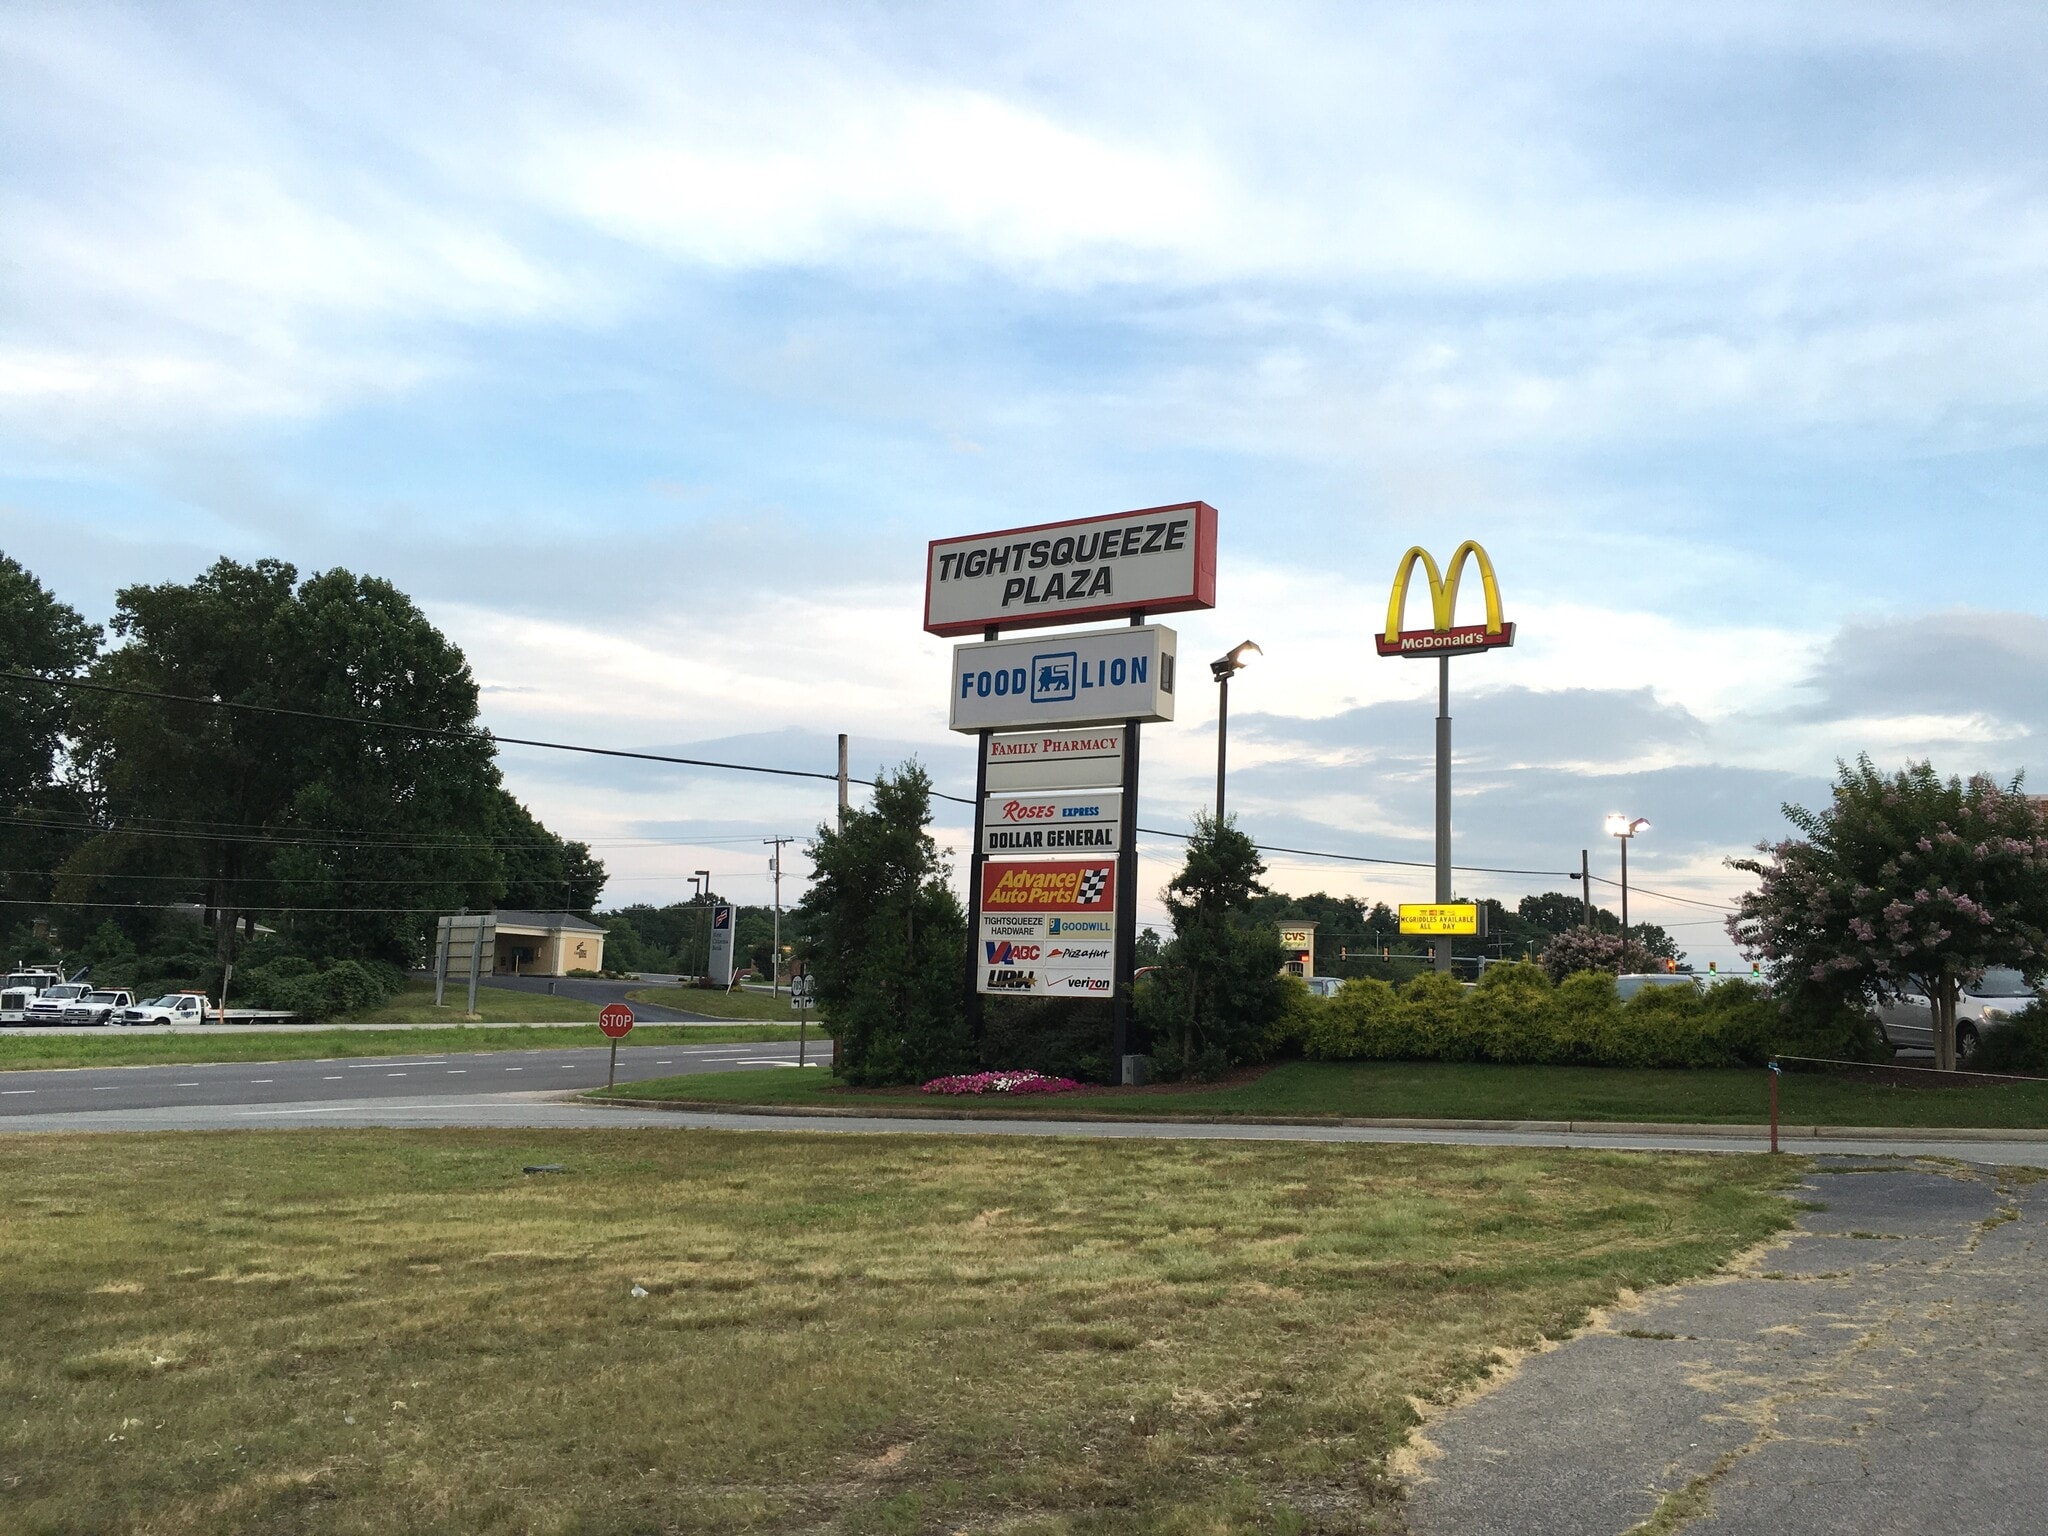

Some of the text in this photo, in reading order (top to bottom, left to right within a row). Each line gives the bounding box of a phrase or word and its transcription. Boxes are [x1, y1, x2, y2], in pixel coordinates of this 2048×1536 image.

[939, 520, 1189, 582] TIGHTSQUEEZE
[1001, 566, 1112, 607] PLAZA
[1401, 633, 1484, 649] McDonald's
[961, 656, 1148, 699] FOOD LION
[991, 738, 1118, 756] FAMILY PHARMACY
[1002, 800, 1100, 822] ROSES EXPRESS
[989, 829, 1112, 849] DOLLAR GENERAL
[997, 870, 1076, 888] Advance
[987, 888, 1073, 903] Auto Parts
[984, 917, 1043, 926] TIGHTSQUEEZE
[1062, 922, 1110, 931] GOODWILL
[991, 927, 1034, 935] HARDWARE
[1284, 932, 1306, 941] CVS
[1068, 977, 1110, 990] verizon
[601, 1014, 632, 1027] STOP
